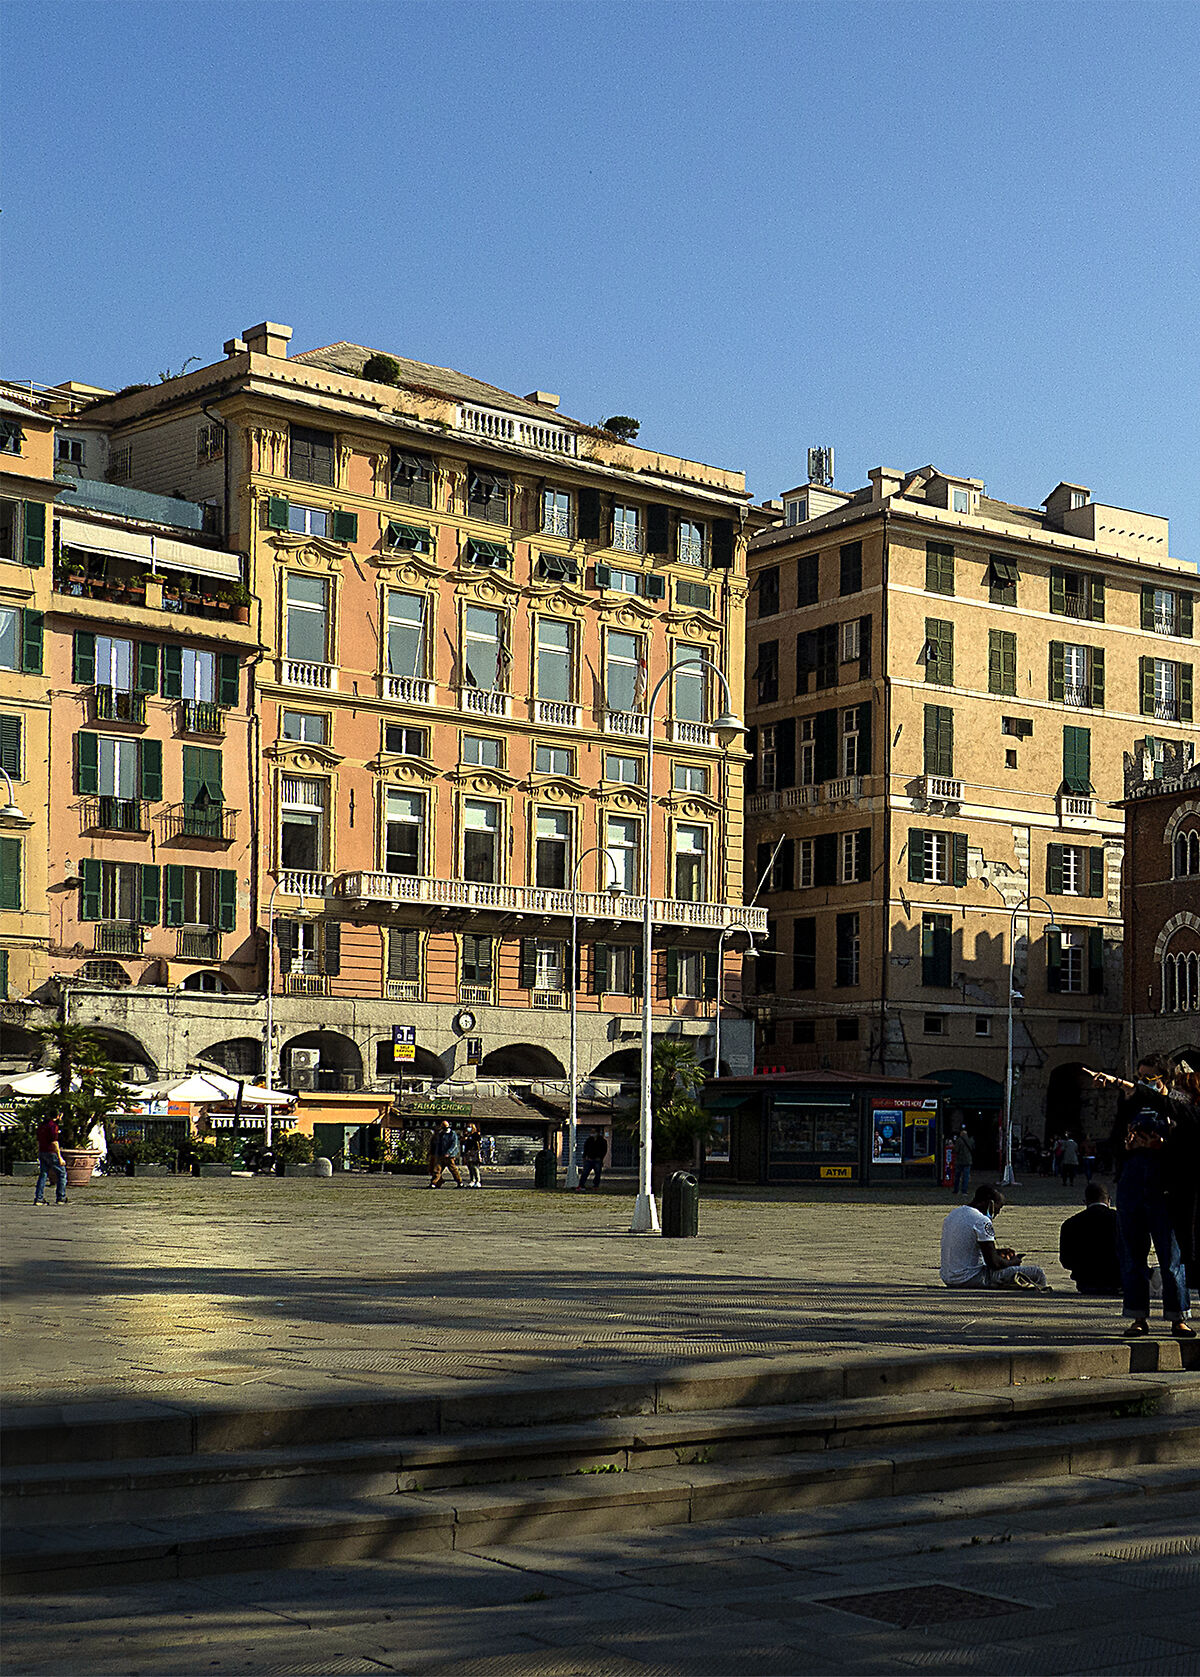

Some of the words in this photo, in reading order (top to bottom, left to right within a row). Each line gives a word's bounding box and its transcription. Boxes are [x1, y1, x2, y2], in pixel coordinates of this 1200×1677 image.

[399, 1026, 411, 1041] T
[469, 1039, 478, 1054] T
[409, 1120, 467, 1128] TABACHI
